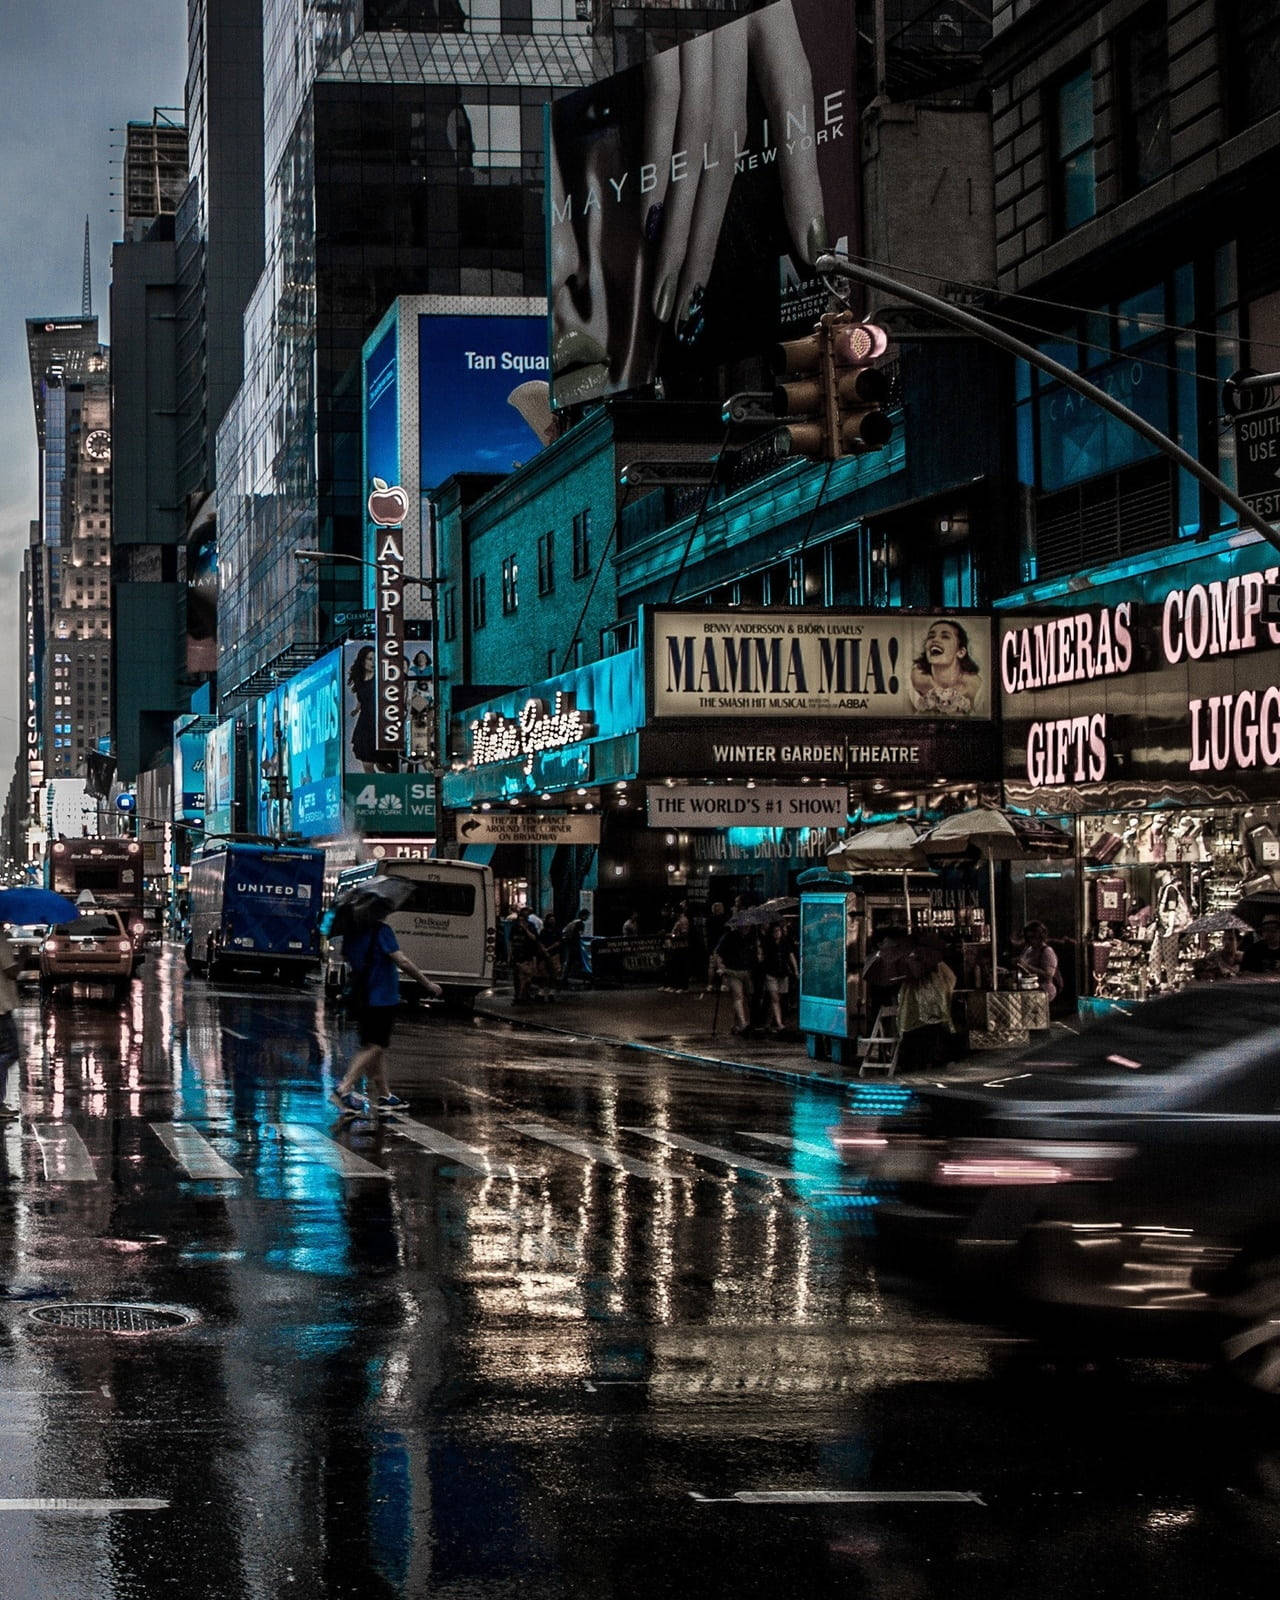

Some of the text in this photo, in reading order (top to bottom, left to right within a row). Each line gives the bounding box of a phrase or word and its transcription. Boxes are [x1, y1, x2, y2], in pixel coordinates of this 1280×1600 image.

[551, 89, 845, 226] MAYBELLINE
[734, 122, 844, 175] NEW YORK
[464, 352, 496, 370] Tan
[1249, 440, 1277, 463] USE
[704, 623, 731, 633] BENNY
[733, 624, 785, 634] ANDERSSON
[788, 625, 795, 633] &
[797, 623, 825, 634] BJÖRN
[1002, 602, 1133, 694] CAMERAS
[666, 636, 899, 695] MAMMA MIA!
[699, 698, 715, 708] THE
[718, 698, 749, 708] SMASH
[751, 698, 766, 708] HIT
[769, 698, 807, 708] MUSICAL
[1188, 686, 1280, 771] LUGG
[712, 744, 920, 763] WINTER GARDEN THEATRE
[1026, 713, 1108, 786] GIFTS
[356, 784, 378, 809] 4
[656, 798, 841, 814] THE WORLD'S #1 SHOW!
[411, 804, 436, 816] WE
[499, 833, 557, 841] ON BROADWAY
[237, 883, 294, 895] UNITED
